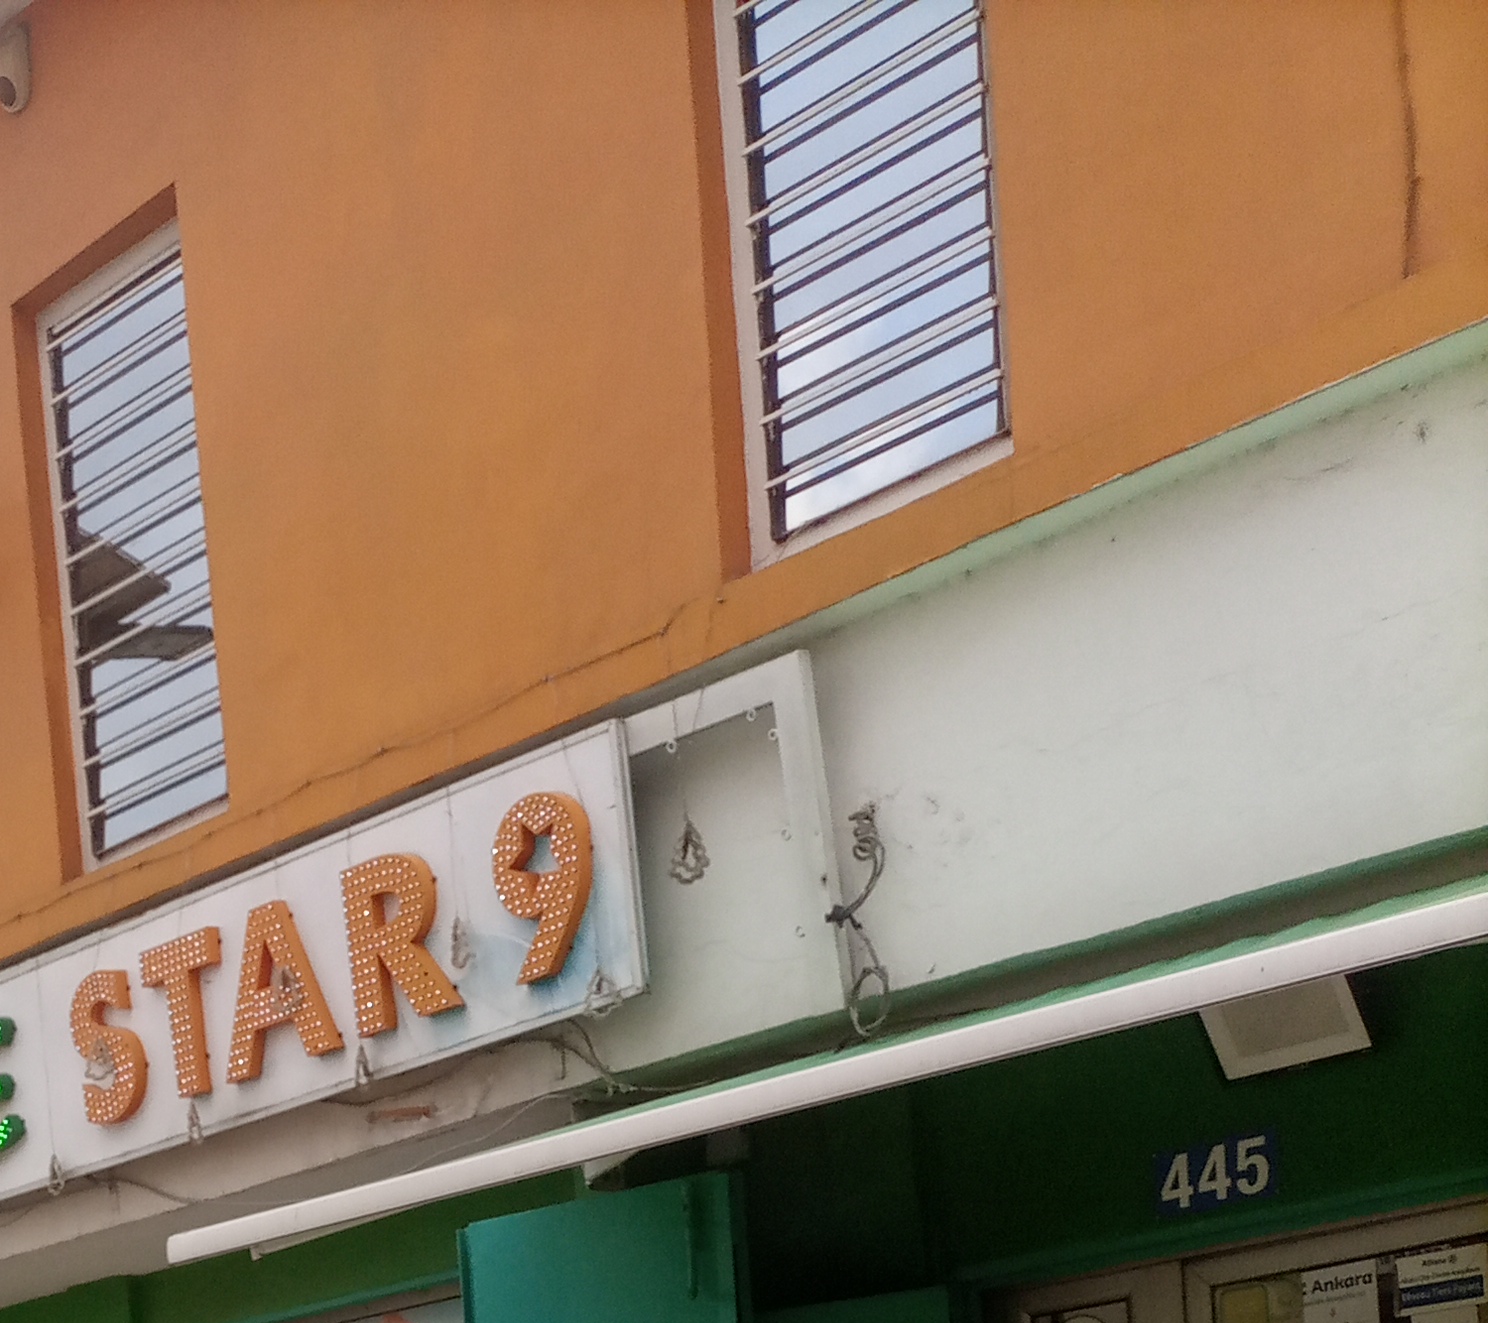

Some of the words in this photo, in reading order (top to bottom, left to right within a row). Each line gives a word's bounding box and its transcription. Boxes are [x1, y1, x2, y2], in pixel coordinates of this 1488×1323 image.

[70, 852, 465, 1125] STAR
[492, 791, 592, 985] 9
[1161, 1135, 1270, 1208] 445
[1311, 1272, 1373, 1295] Ankara
